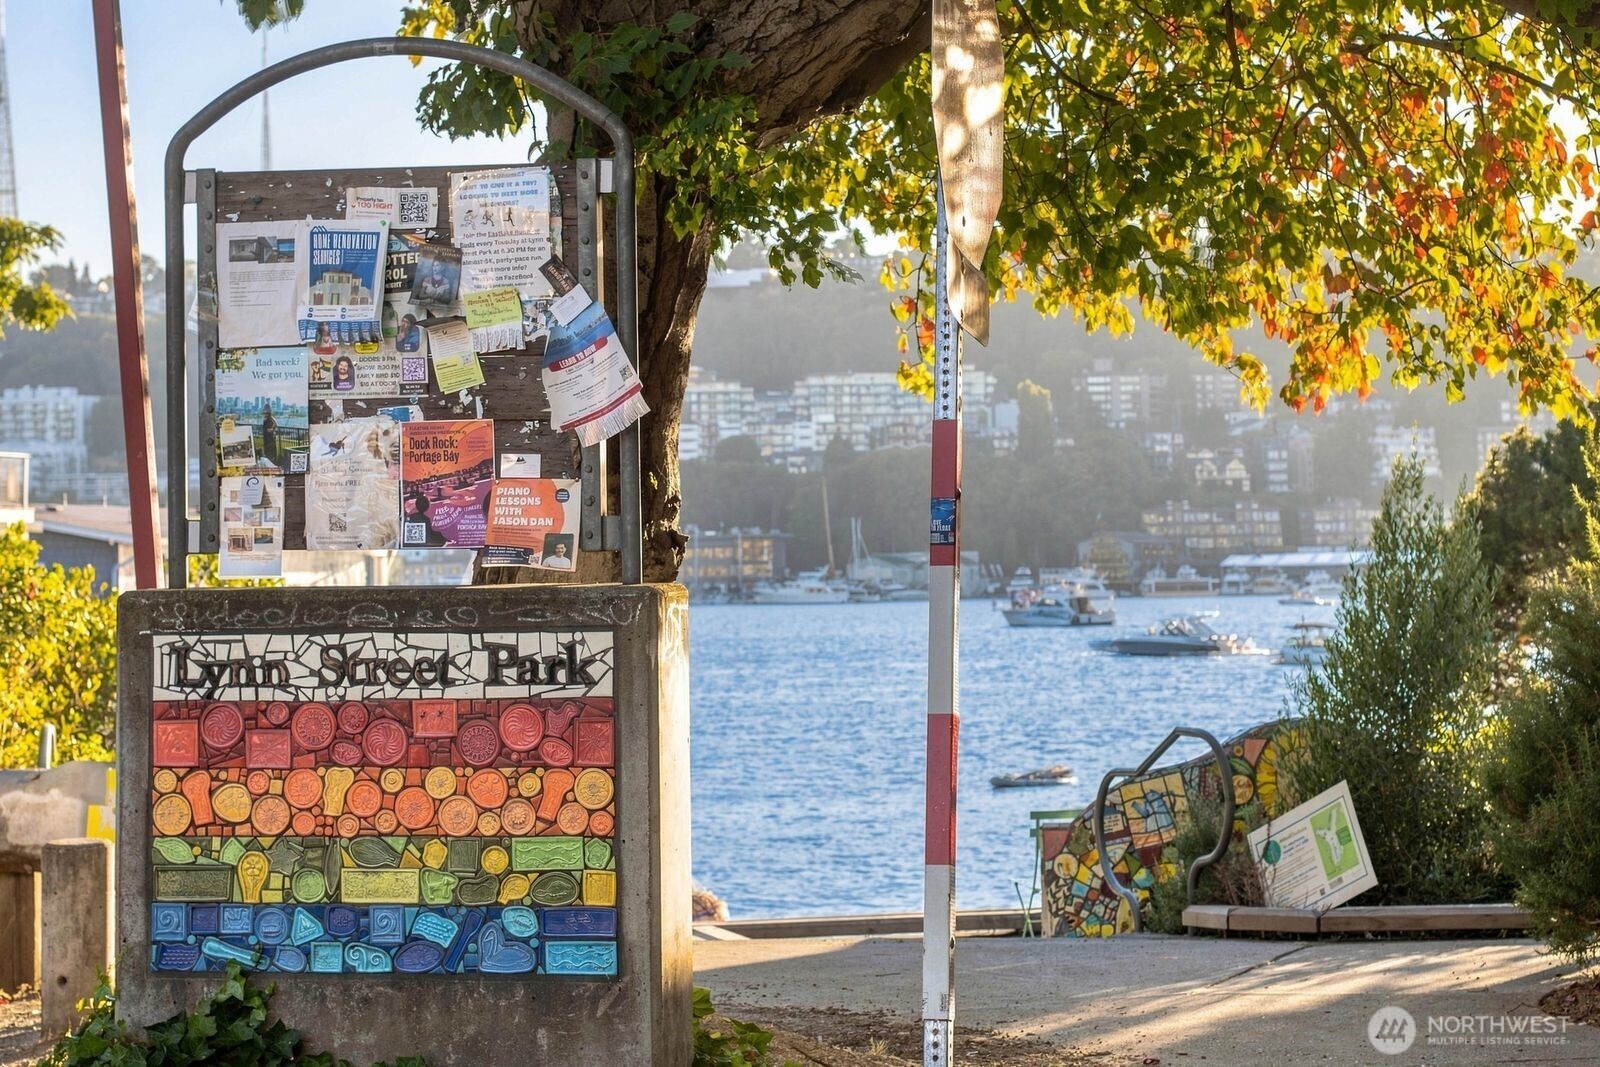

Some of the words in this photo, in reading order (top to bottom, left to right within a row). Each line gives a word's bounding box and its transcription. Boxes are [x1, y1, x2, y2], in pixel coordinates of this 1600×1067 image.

[256, 358, 272, 367] Bad
[274, 358, 300, 366] week?
[252, 371, 266, 379] We
[268, 372, 282, 380] got
[410, 436, 430, 450] Dock
[432, 436, 458, 448] Rock:
[410, 450, 442, 464] Portage
[444, 450, 460, 464] Bay
[496, 488, 530, 496] PIANO
[496, 497, 542, 506] LESSONS
[494, 506, 522, 516] WITH
[492, 518, 528, 526] JASON
[530, 518, 554, 526] DAN
[173, 645, 292, 700] Lynn
[320, 643, 459, 687] Street
[485, 640, 598, 687] Park
